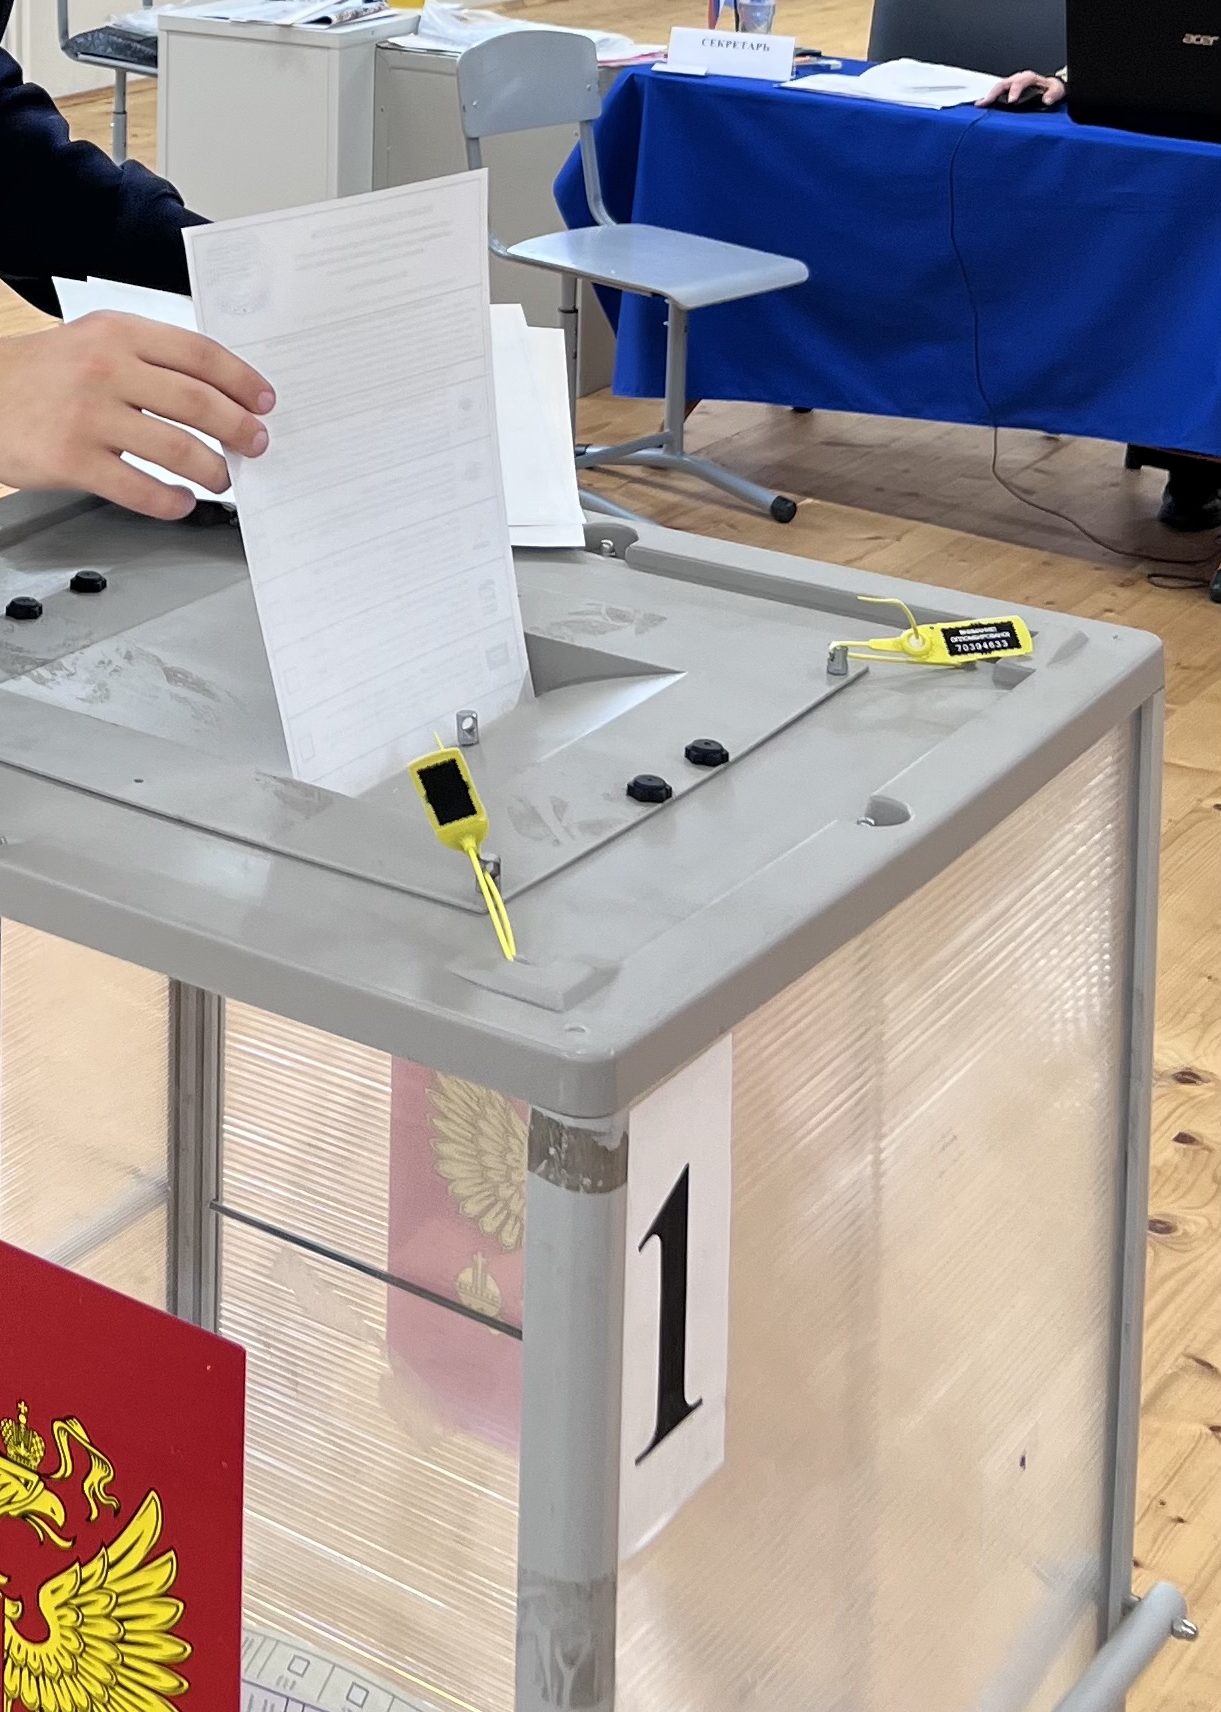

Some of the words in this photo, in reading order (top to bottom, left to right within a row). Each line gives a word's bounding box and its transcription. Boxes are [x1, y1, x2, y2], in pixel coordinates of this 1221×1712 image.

[701, 38, 770, 52] СЕКРЕТАРЬ
[1182, 33, 1219, 46] acer
[635, 1162, 703, 1467] 1
